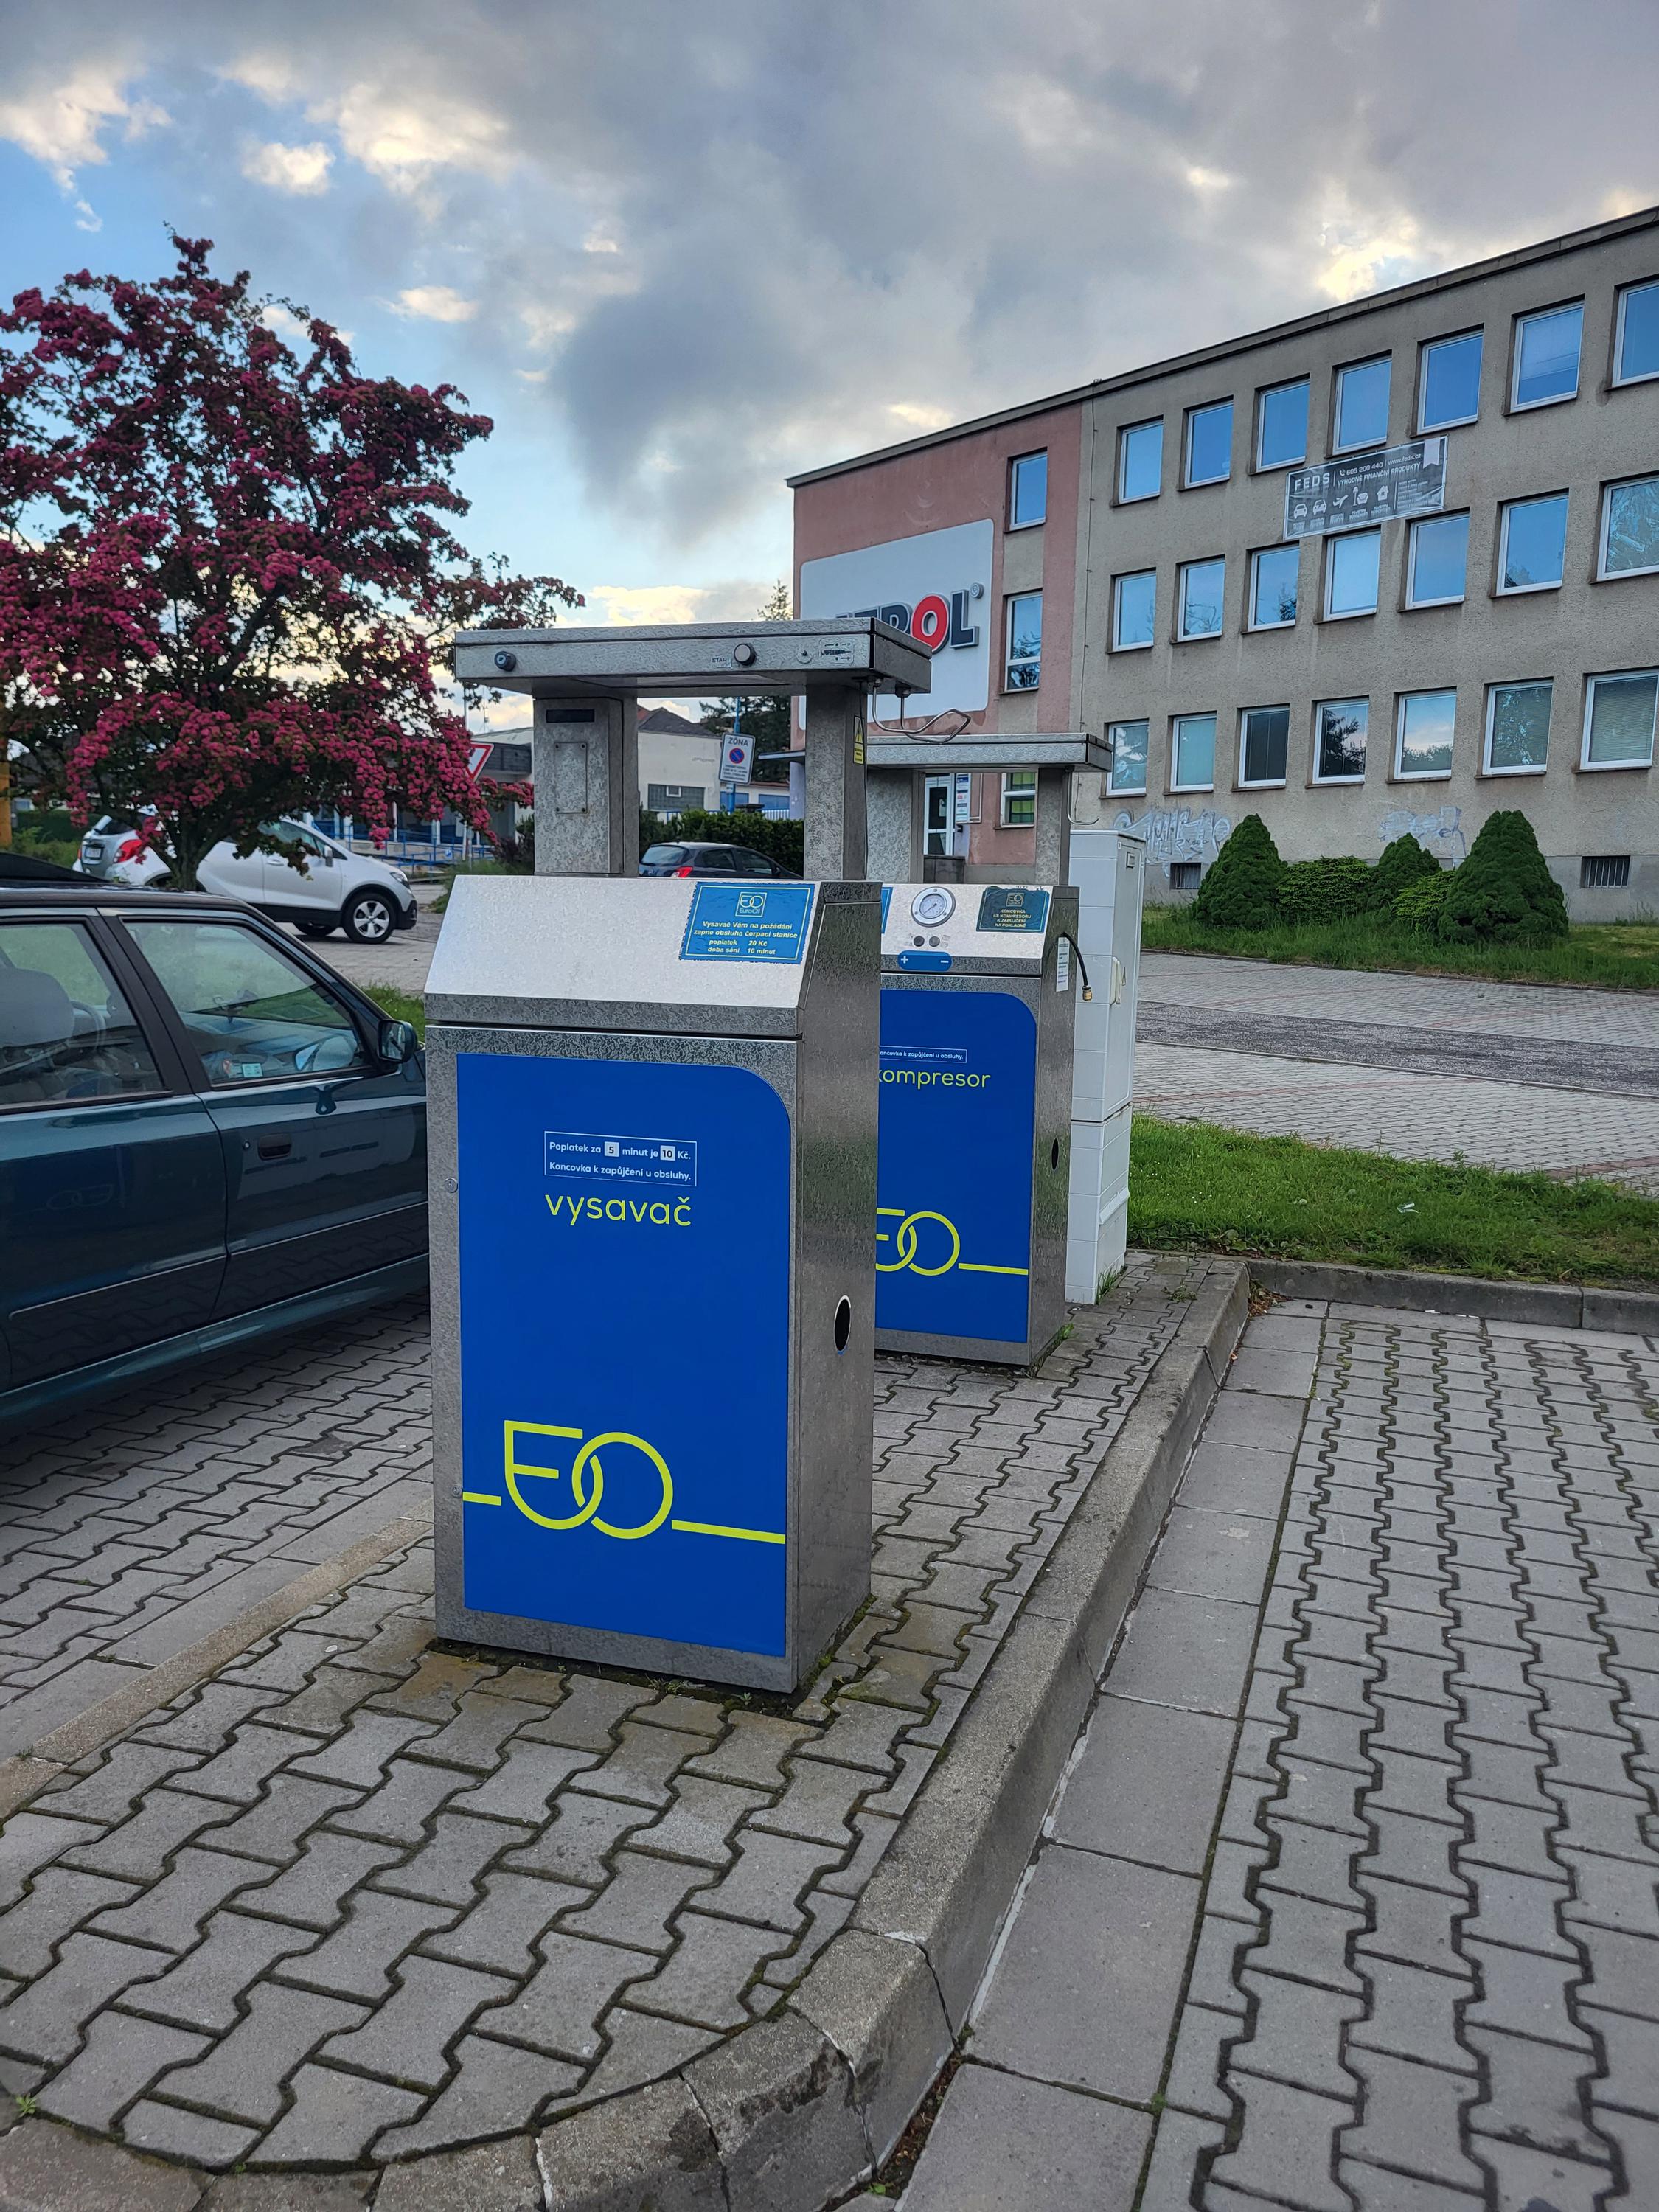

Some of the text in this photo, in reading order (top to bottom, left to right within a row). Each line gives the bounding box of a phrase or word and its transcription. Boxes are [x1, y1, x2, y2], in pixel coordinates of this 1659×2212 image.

[1359, 465, 1371, 473] 200
[1371, 462, 1383, 470] 440
[1388, 453, 1422, 465] www.feds.cz
[1391, 462, 1422, 474] PRODUKTY
[1295, 473, 1330, 491] FEDS
[728, 737, 749, 747] ZÓNA
[745, 930, 771, 938] čerpací
[549, 1141, 691, 1160] Poplatek za 5 minut je 10 Kč.
[549, 1162, 692, 1181] Koncovka k zapůjčení u obsluhy.
[545, 1194, 692, 1226] vysavač
